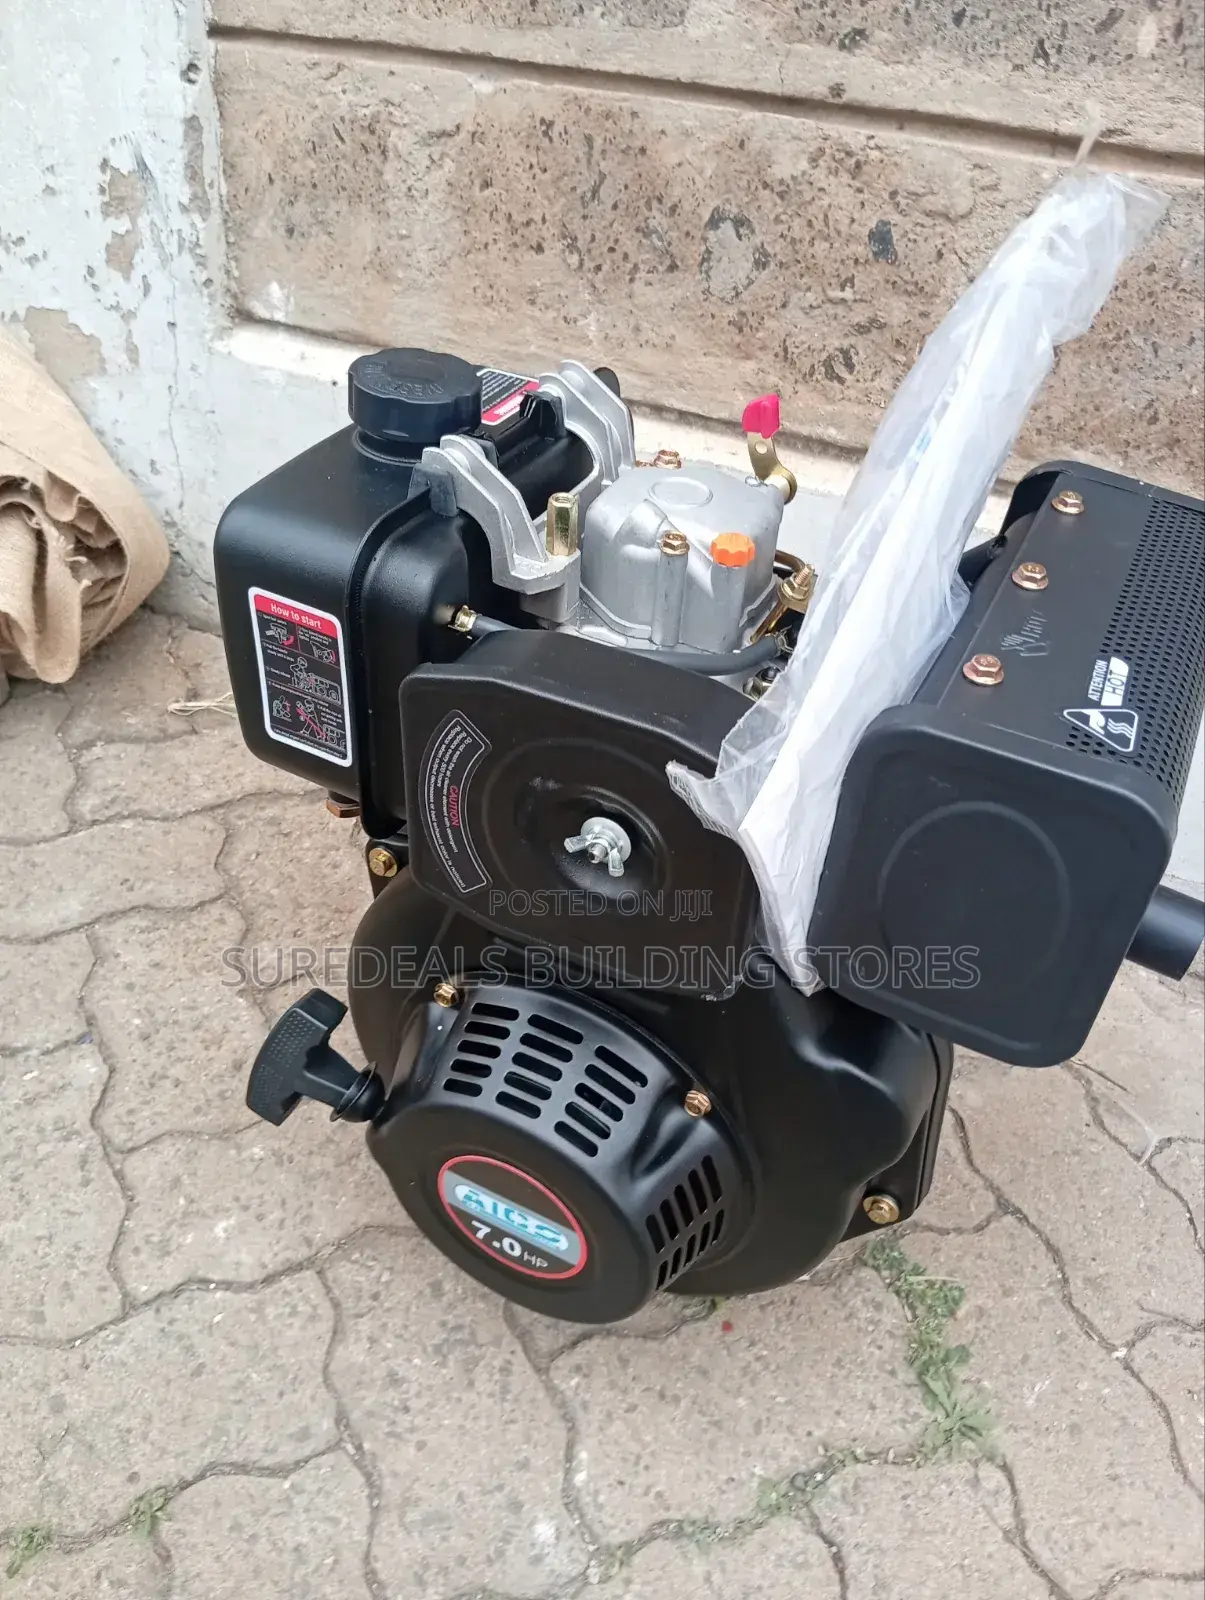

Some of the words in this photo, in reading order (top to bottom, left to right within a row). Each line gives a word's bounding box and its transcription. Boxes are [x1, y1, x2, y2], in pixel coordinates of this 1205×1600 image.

[271, 603, 289, 617] How
[290, 610, 300, 621] to
[301, 615, 322, 629] start
[1088, 659, 1108, 701] ATTENTION
[1105, 670, 1128, 696] HOT
[444, 725, 462, 745] Replace
[450, 731, 467, 750] Replace
[464, 736, 473, 745] Do
[449, 785, 460, 826] CAUTION
